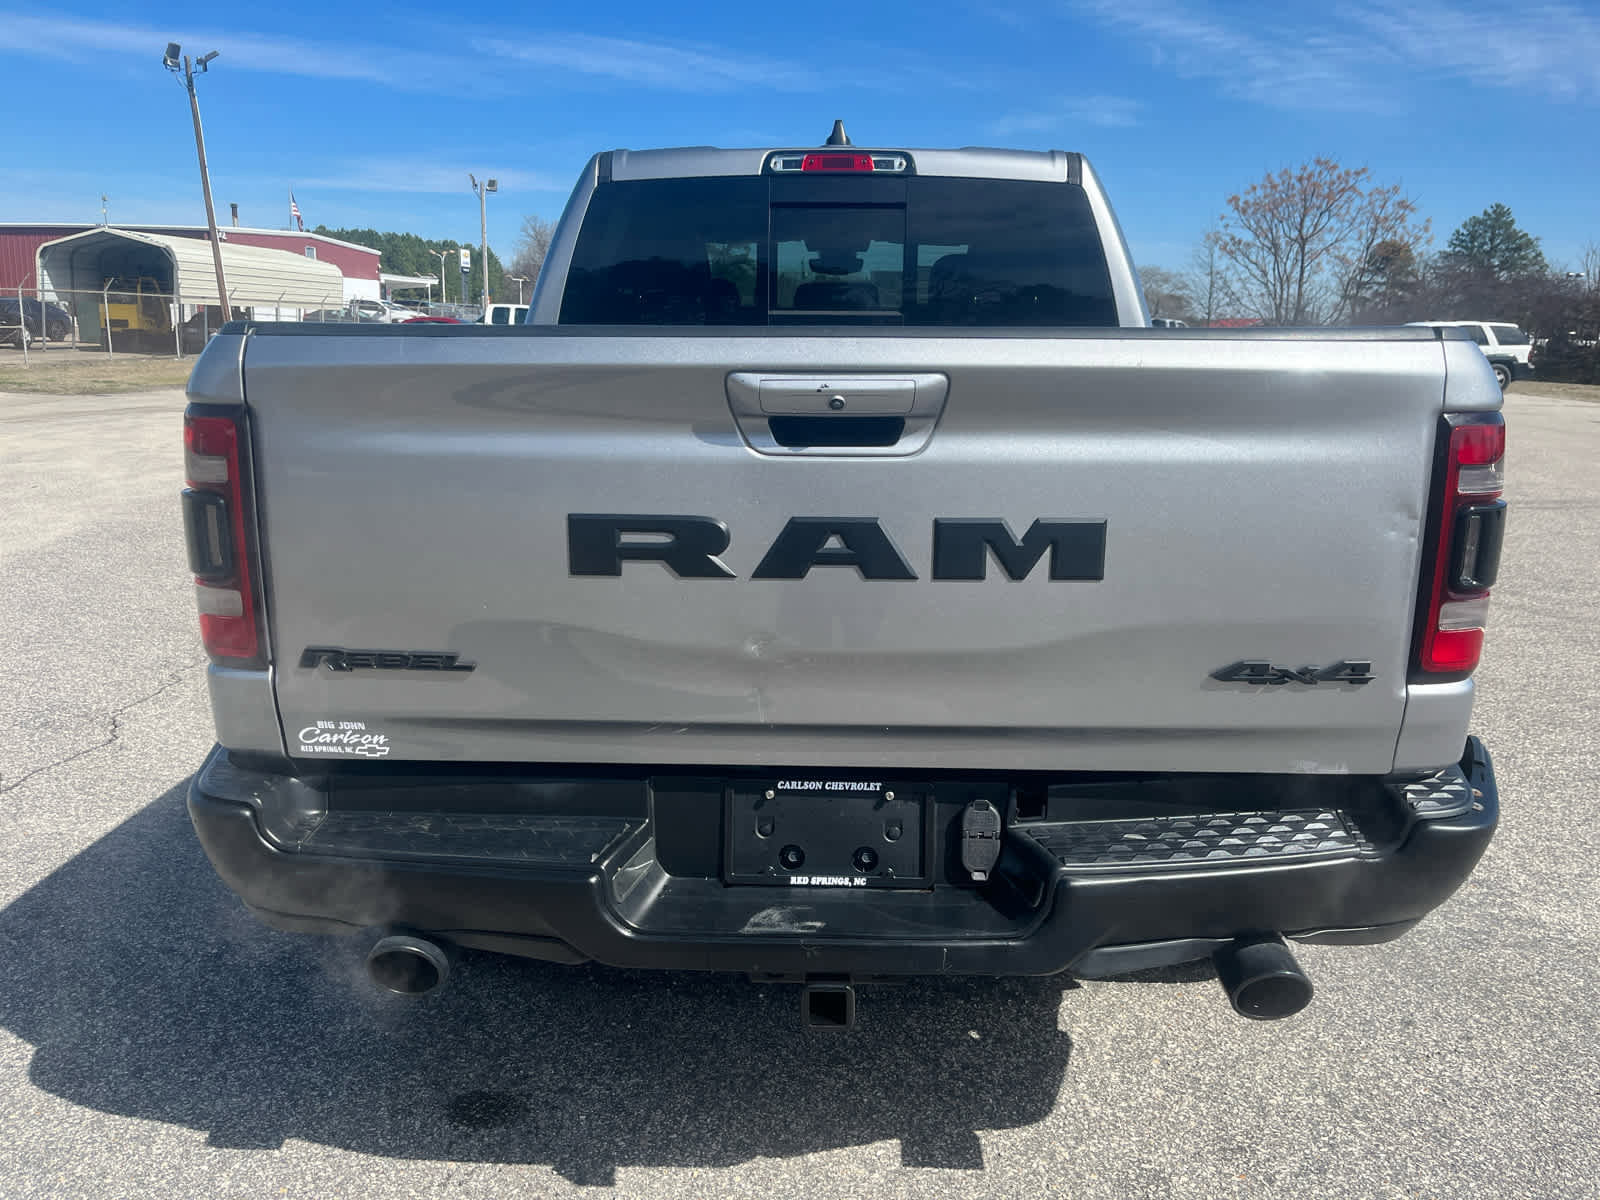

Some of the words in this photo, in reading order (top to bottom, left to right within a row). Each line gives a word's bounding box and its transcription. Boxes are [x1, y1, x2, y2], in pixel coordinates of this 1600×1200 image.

[567, 513, 1108, 582] RAM
[298, 646, 478, 672] REBEL
[316, 720, 335, 729] BIG
[338, 721, 366, 730] JOHN
[298, 727, 389, 744] Carlson
[777, 780, 823, 790] CARLSON
[825, 781, 882, 791] CHEVROLET
[790, 876, 809, 885] RED
[810, 877, 852, 886] SPRINGS,
[853, 878, 867, 886] NC
